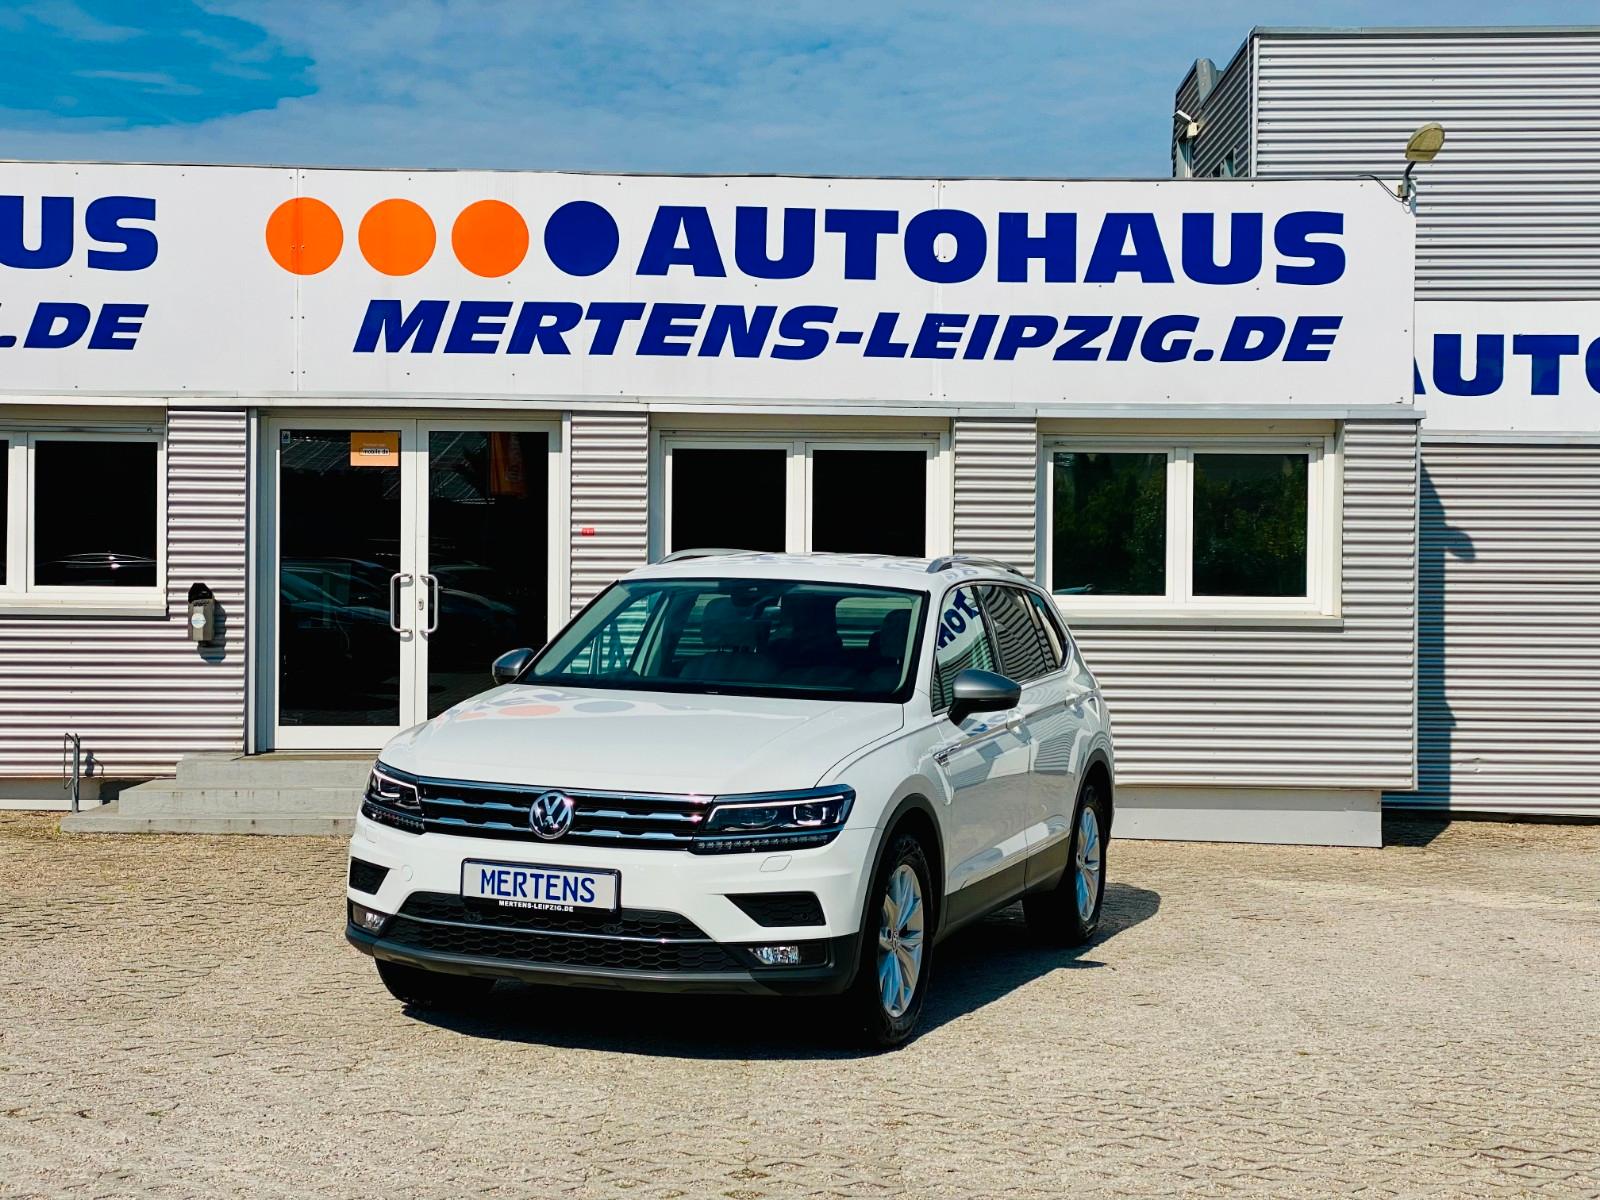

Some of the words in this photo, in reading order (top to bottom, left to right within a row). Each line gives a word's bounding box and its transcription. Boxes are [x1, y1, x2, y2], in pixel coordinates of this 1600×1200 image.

[0, 195, 158, 271] US
[636, 205, 1346, 286] AUTOHAUS
[353, 299, 1343, 362] MERTENS-LEIPZIG.DE
[1414, 333, 1600, 397] UT
[480, 868, 596, 904] MERTENS
[498, 899, 575, 913] MERTENS-LEIPZIG.DE
